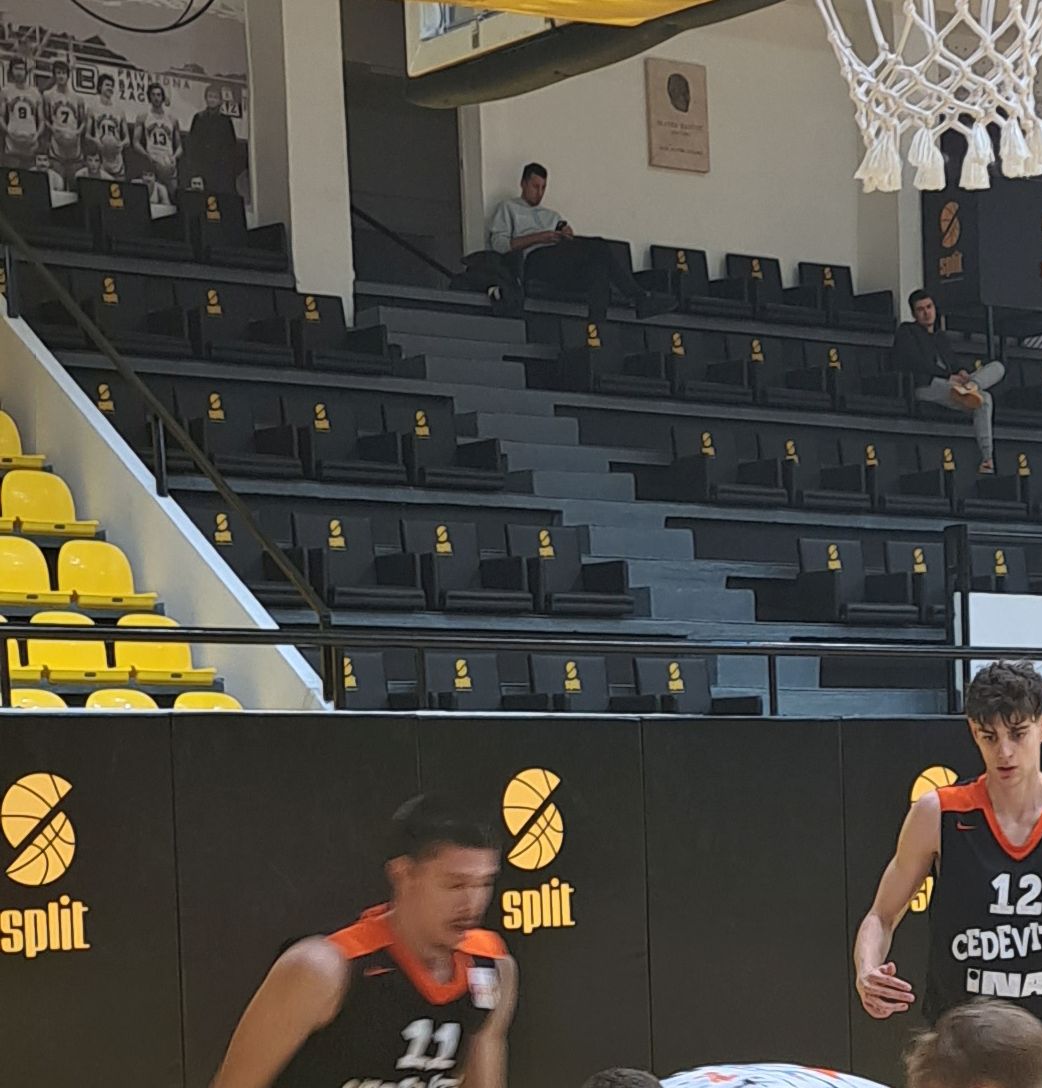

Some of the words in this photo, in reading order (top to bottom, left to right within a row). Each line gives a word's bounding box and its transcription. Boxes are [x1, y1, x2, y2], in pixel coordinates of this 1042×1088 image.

[939, 250, 963, 277] split
[502, 877, 576, 934] split
[989, 873, 1042, 915] 12
[0, 894, 91, 958] split
[396, 1018, 462, 1070] 11
